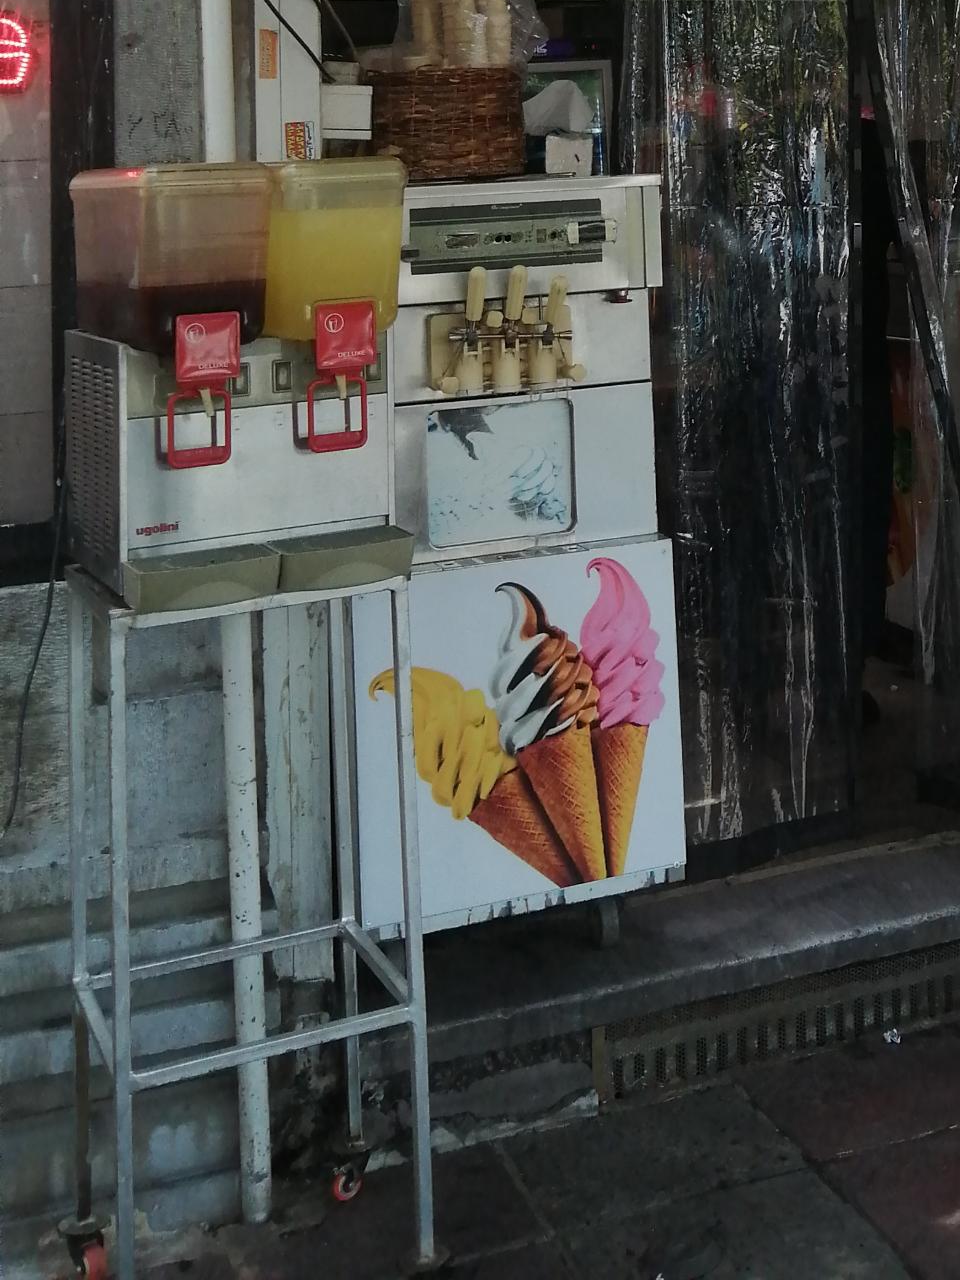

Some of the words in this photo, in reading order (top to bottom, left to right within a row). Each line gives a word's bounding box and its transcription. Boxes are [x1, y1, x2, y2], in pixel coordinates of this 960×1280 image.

[337, 350, 366, 359] DELUXE
[198, 359, 229, 370] DELUXE
[136, 521, 179, 536] ugolini
